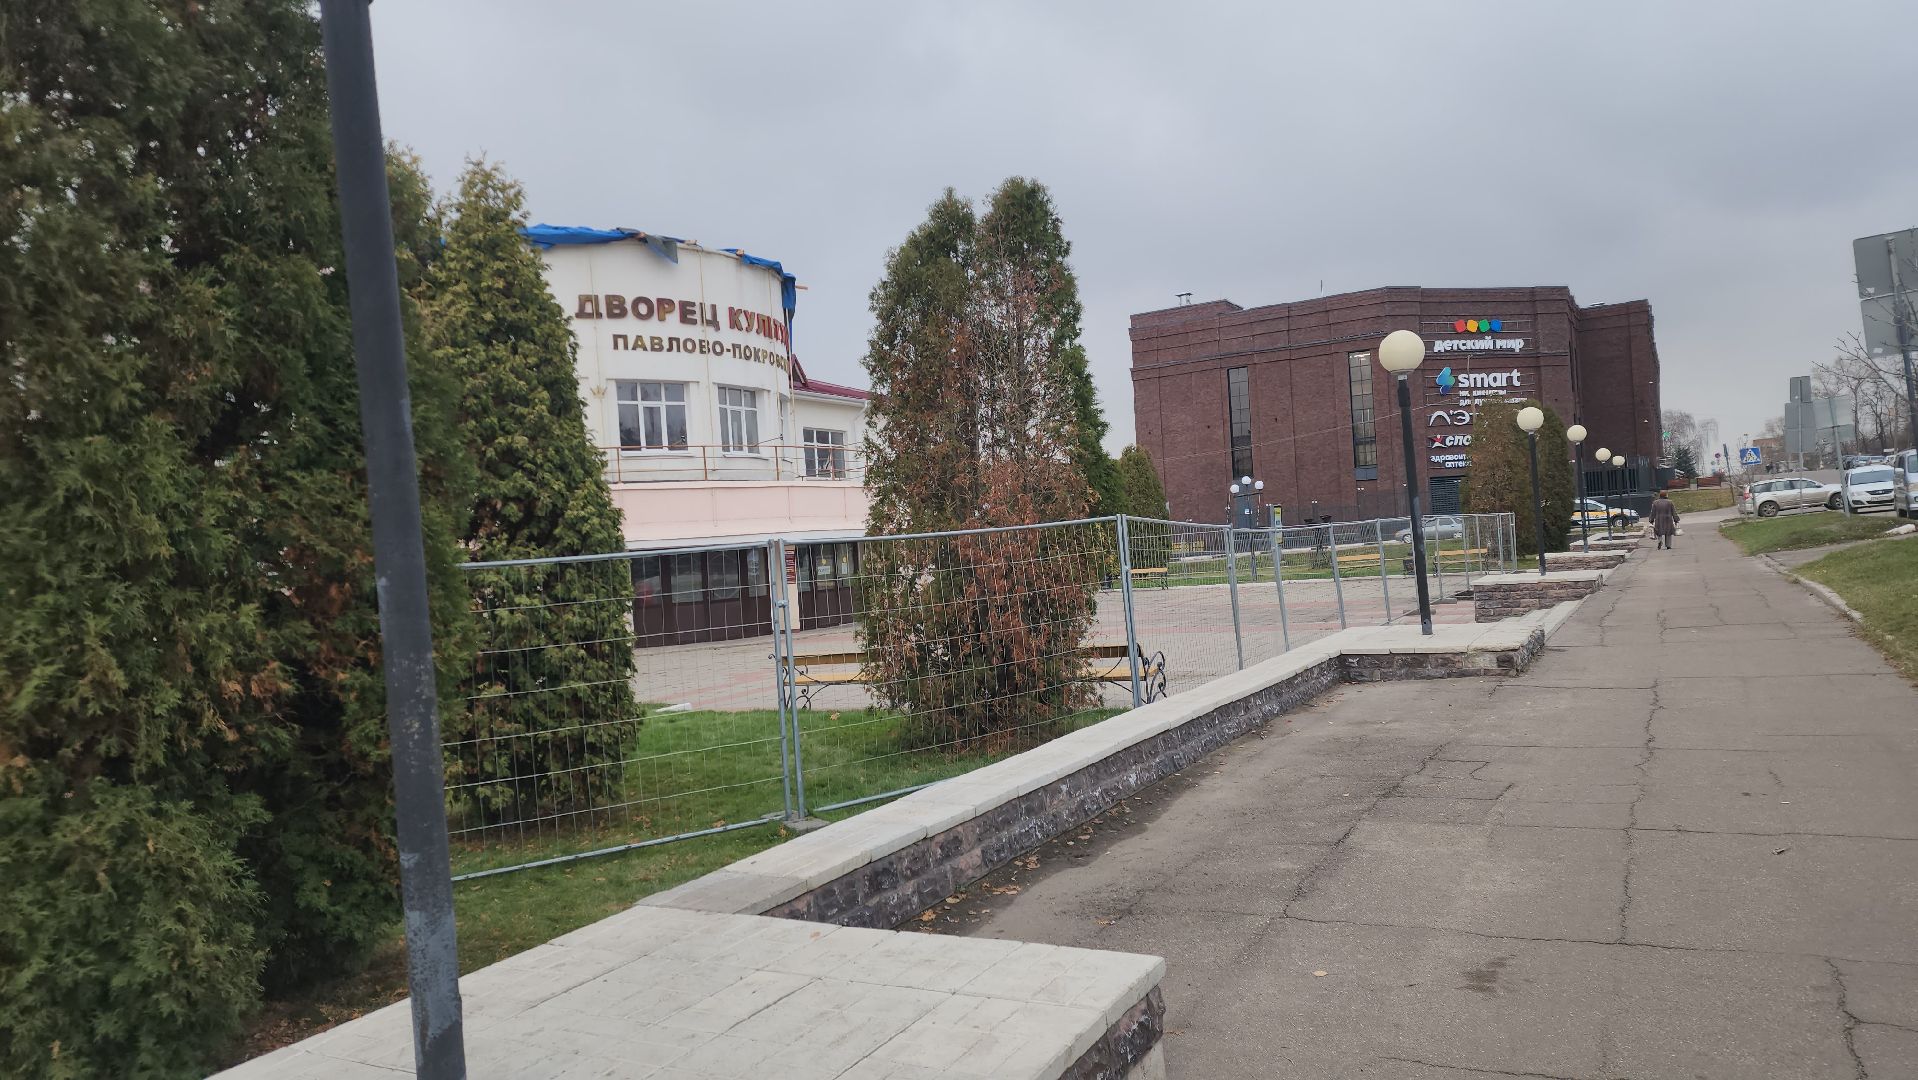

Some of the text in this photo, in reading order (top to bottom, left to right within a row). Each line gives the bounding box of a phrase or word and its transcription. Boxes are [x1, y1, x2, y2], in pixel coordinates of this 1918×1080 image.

[575, 294, 721, 332] ДВОРЕЦ
[1434, 336, 1524, 352] детский мир
[1458, 369, 1520, 387] smart
